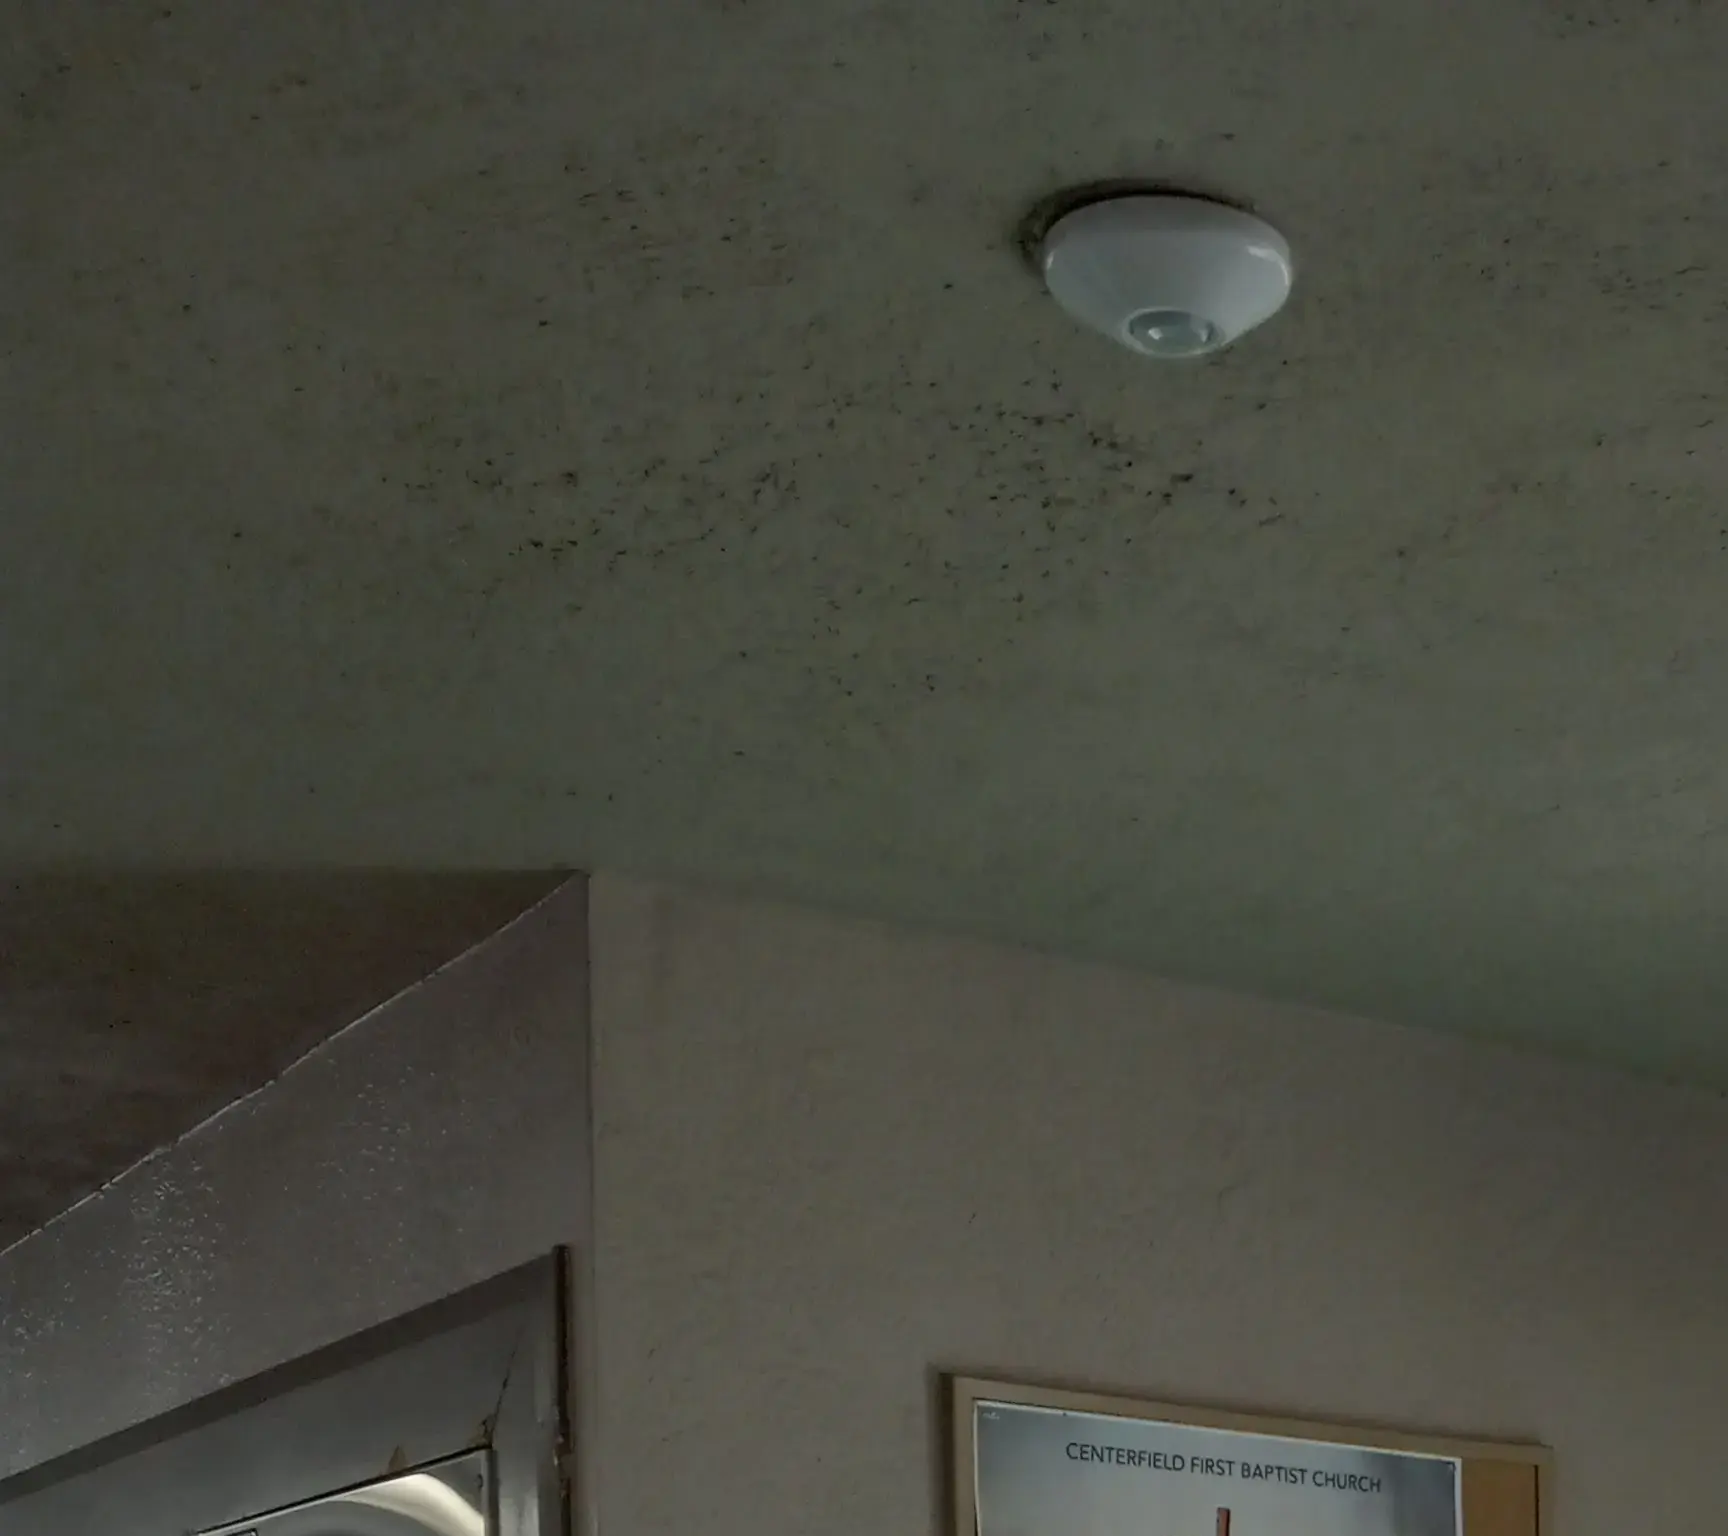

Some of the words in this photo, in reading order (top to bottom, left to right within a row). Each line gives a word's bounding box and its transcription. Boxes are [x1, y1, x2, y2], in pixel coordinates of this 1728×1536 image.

[1065, 1441, 1185, 1472] CENTERFIELD
[1190, 1456, 1236, 1477] FIRST
[1241, 1461, 1308, 1486] BAPTIST
[1312, 1470, 1382, 1494] CHURCH
